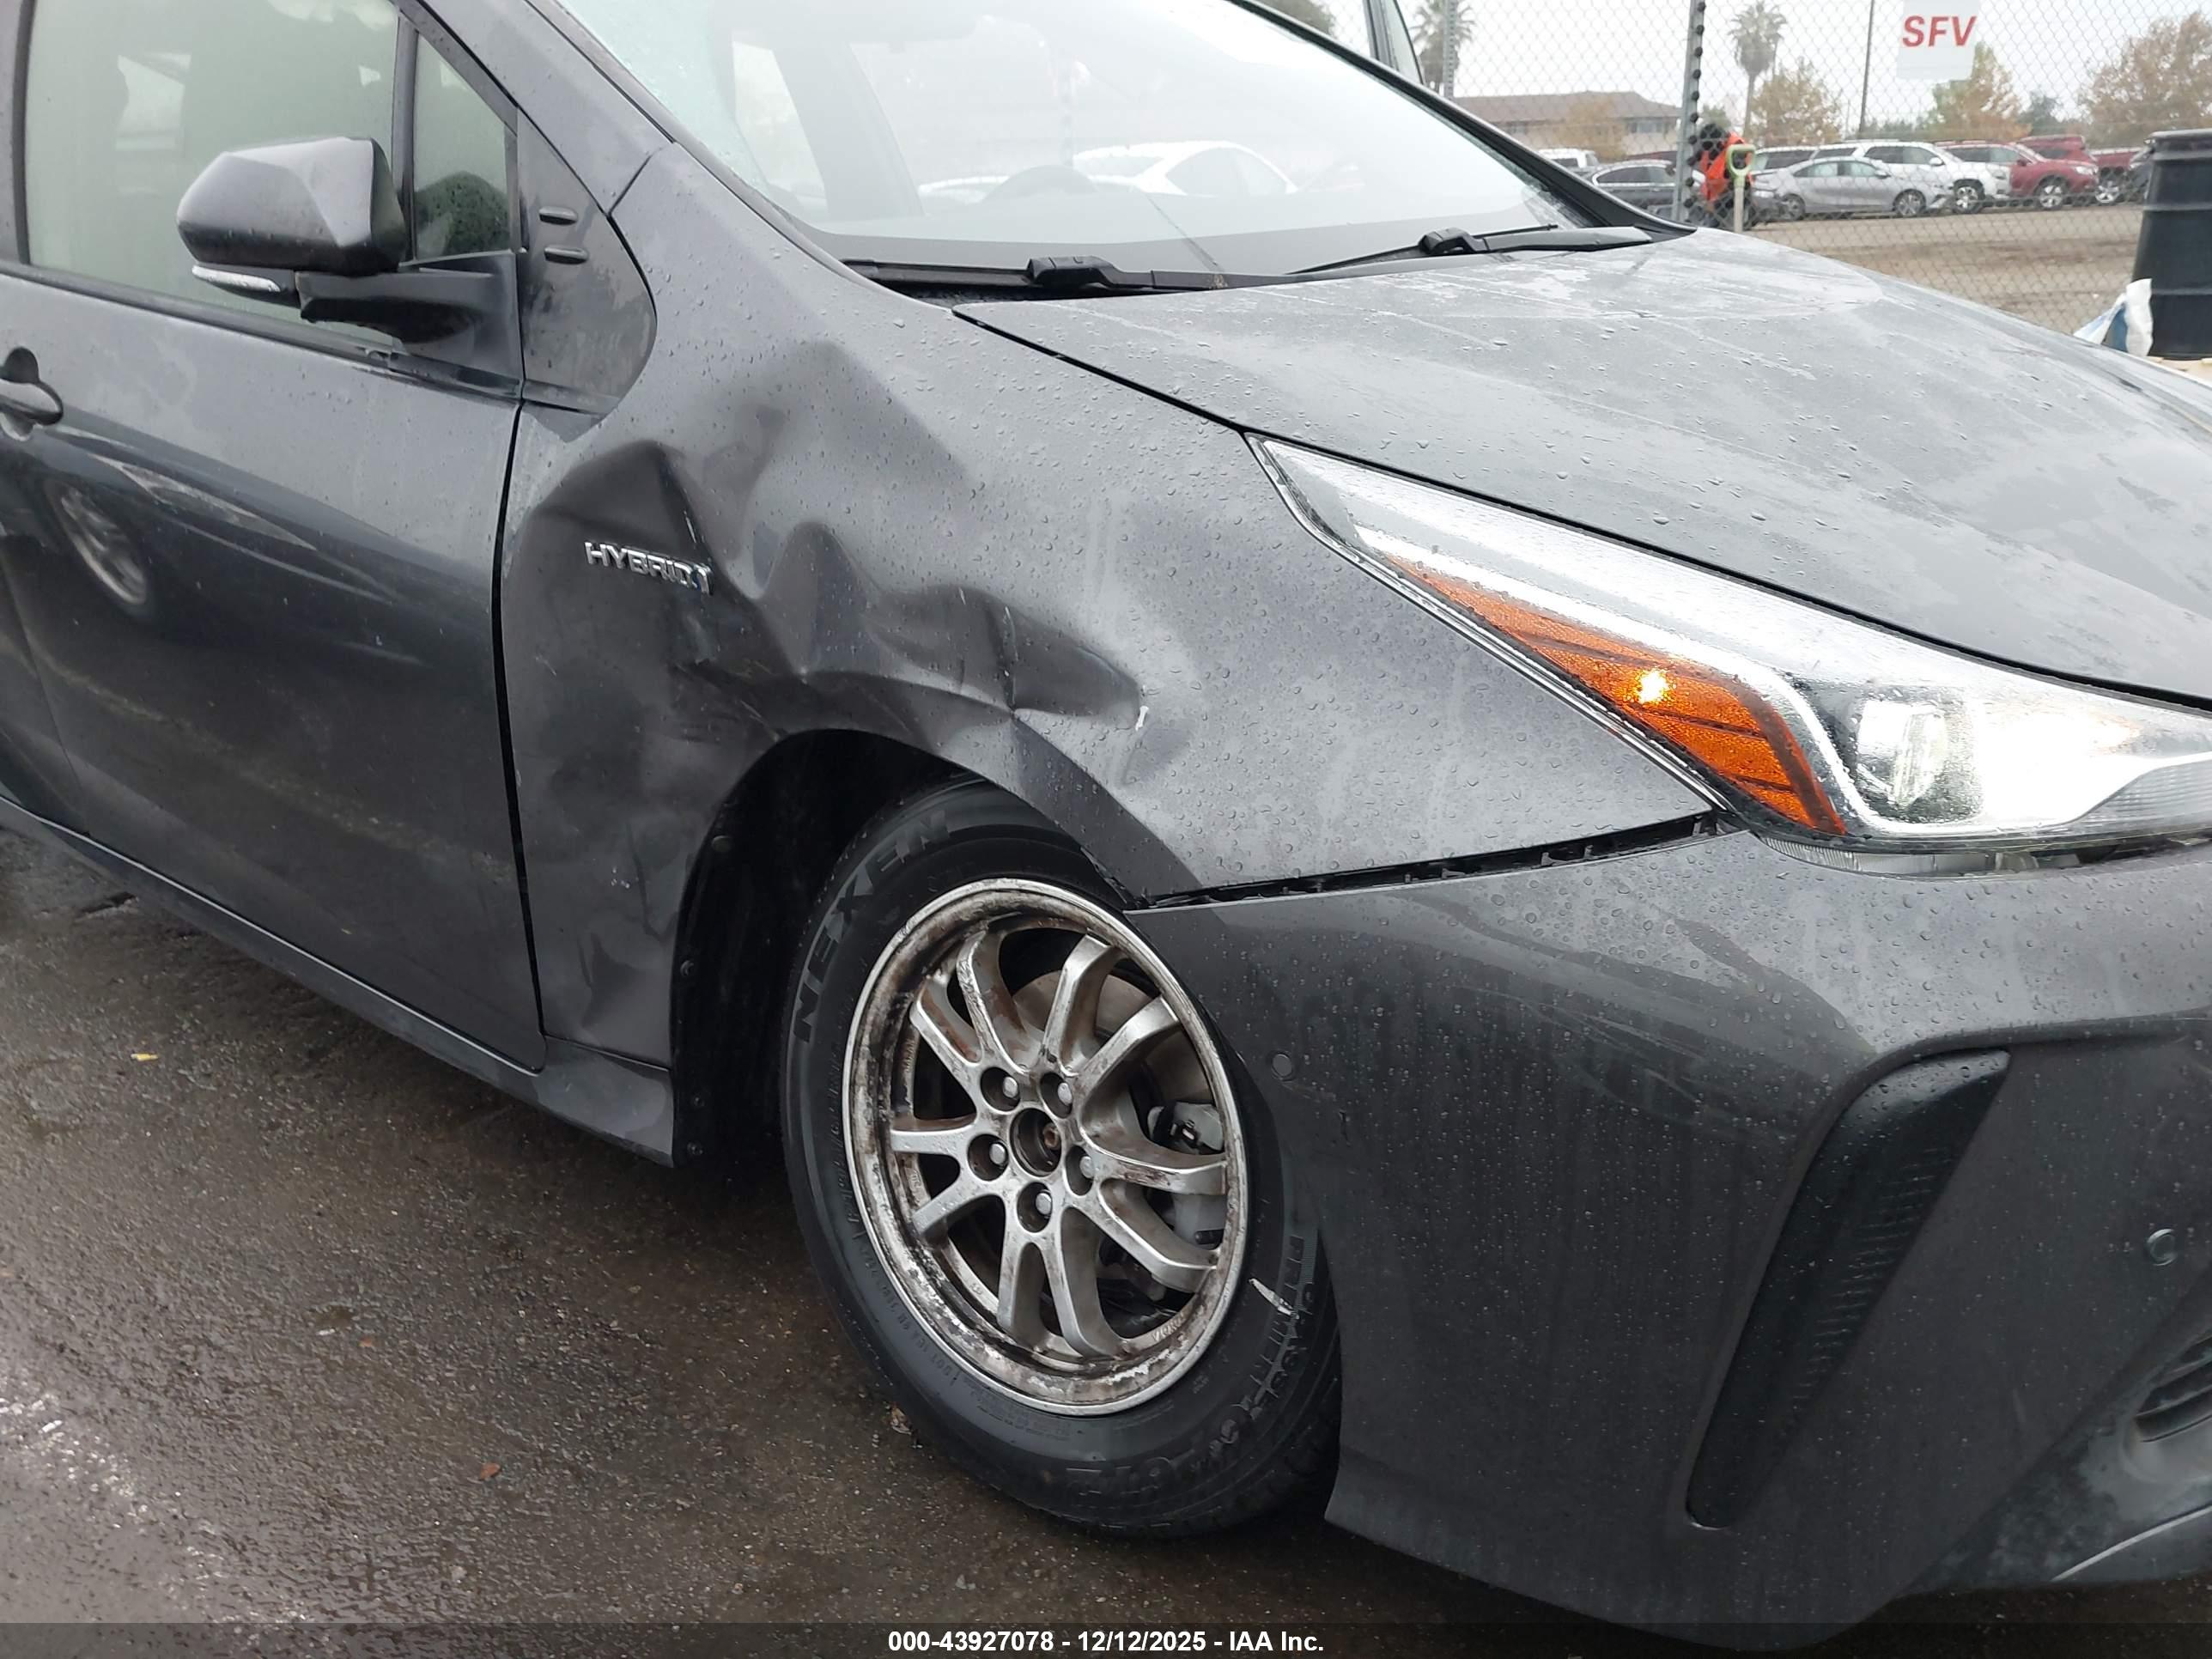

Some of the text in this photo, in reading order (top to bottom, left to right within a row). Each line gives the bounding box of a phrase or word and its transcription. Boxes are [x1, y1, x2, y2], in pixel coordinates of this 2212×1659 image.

[1902, 15, 1977, 47] SFV
[585, 541, 713, 595] HYBRID
[793, 809, 951, 1043] NEXEN
